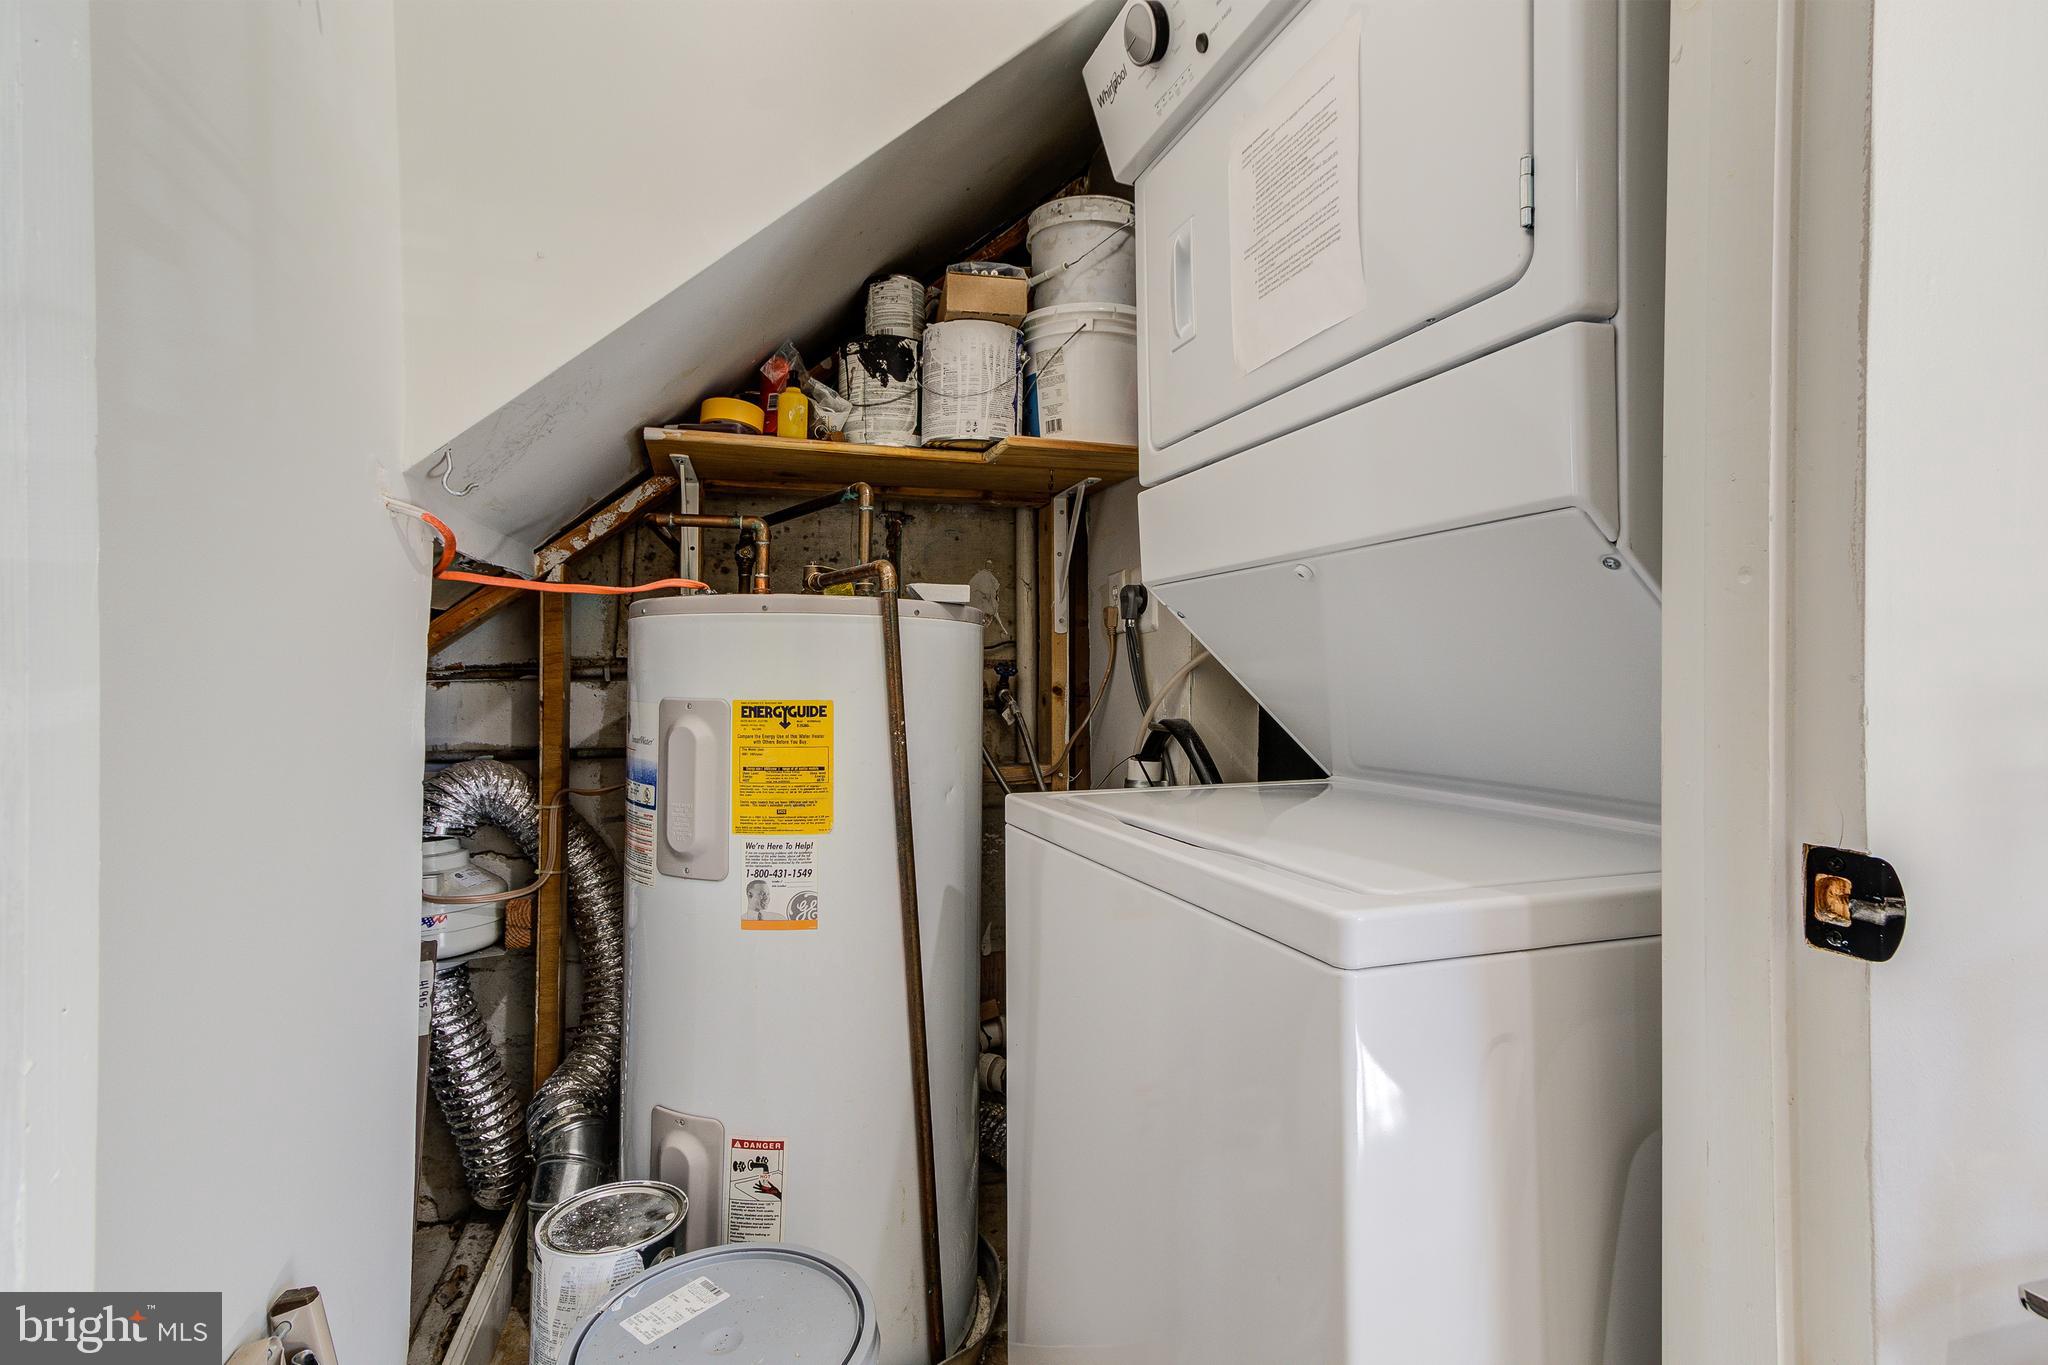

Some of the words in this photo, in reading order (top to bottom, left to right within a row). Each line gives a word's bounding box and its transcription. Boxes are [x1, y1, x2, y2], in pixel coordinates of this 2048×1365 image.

[1096, 64, 1128, 109] Whirlpool
[741, 705, 828, 719] ENERGYGUIDE
[745, 842, 765, 850] We're
[766, 842, 783, 850] Here
[785, 842, 793, 850] To
[795, 842, 814, 852] Help!
[746, 869, 813, 879] 1-800-431-1549
[743, 1142, 781, 1150] DANGER
